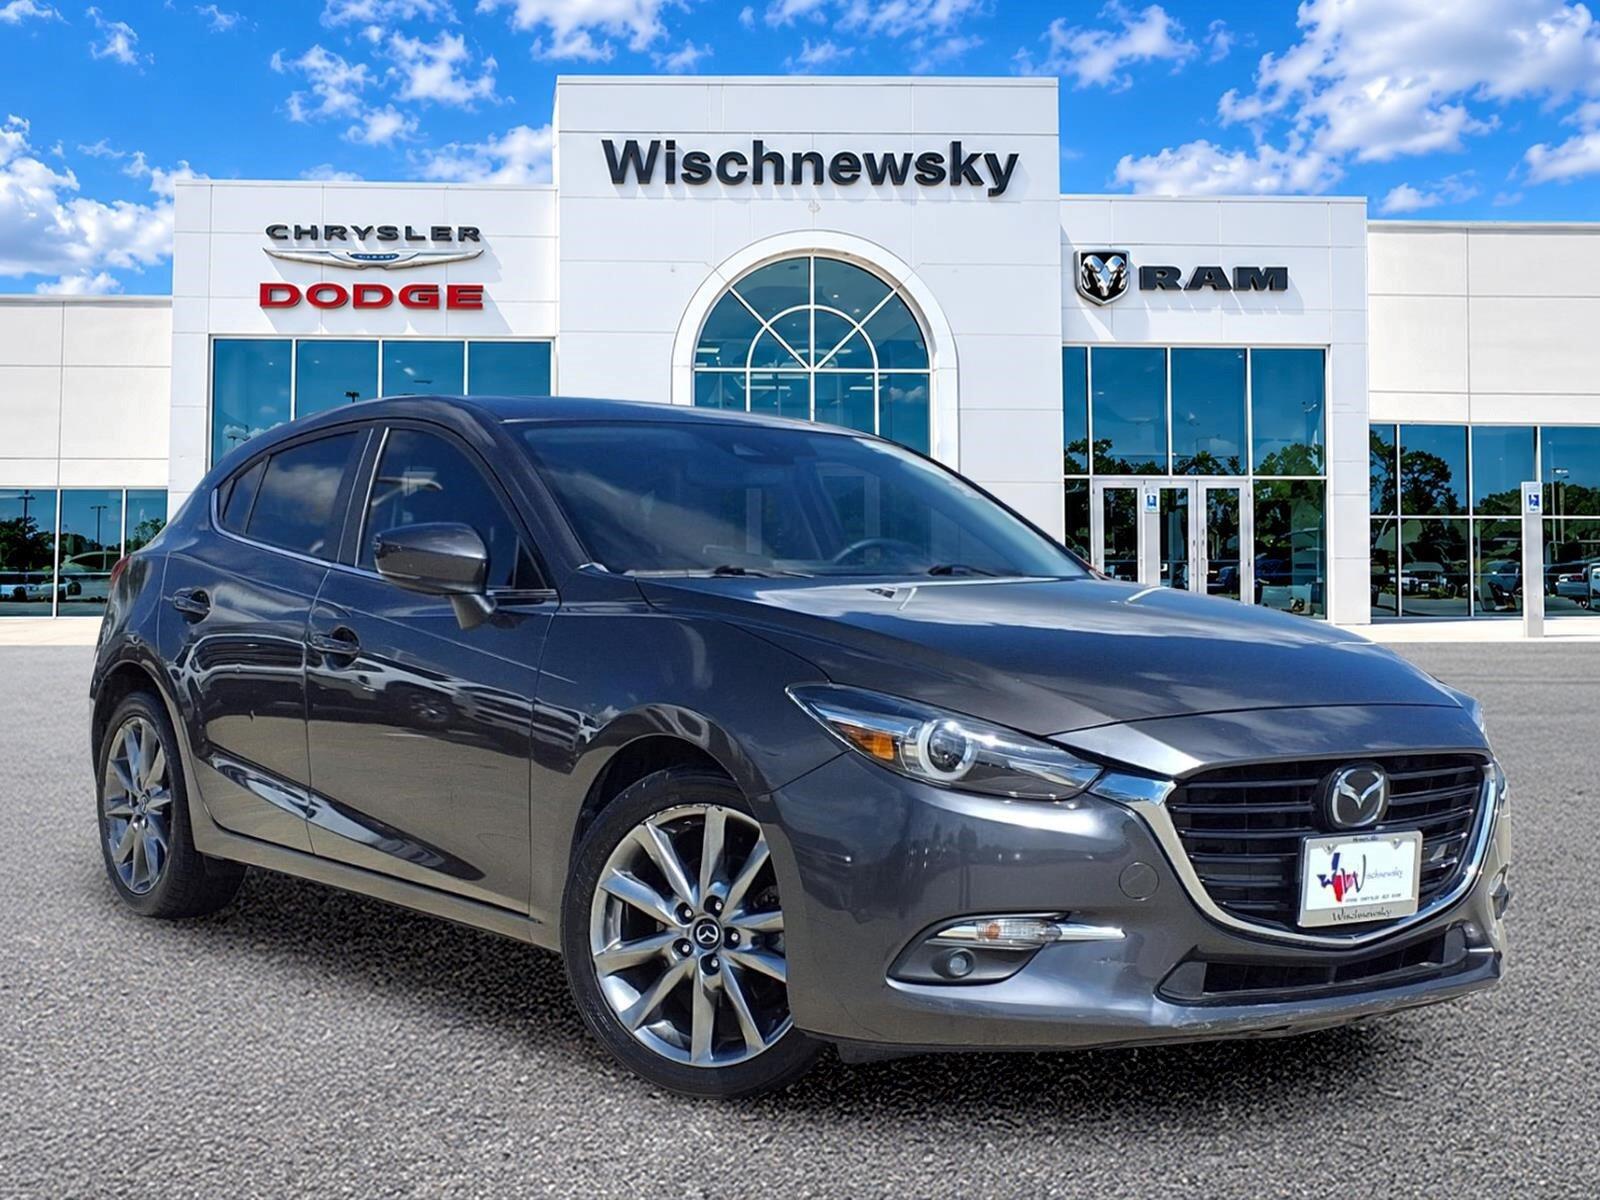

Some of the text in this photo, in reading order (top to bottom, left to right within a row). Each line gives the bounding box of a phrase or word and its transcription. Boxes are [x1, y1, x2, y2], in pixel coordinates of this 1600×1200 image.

[601, 139, 1020, 197] Wischnewsky
[265, 224, 481, 242] CHRYSLER
[1138, 266, 1288, 291] RAM
[260, 283, 484, 310] DODGE
